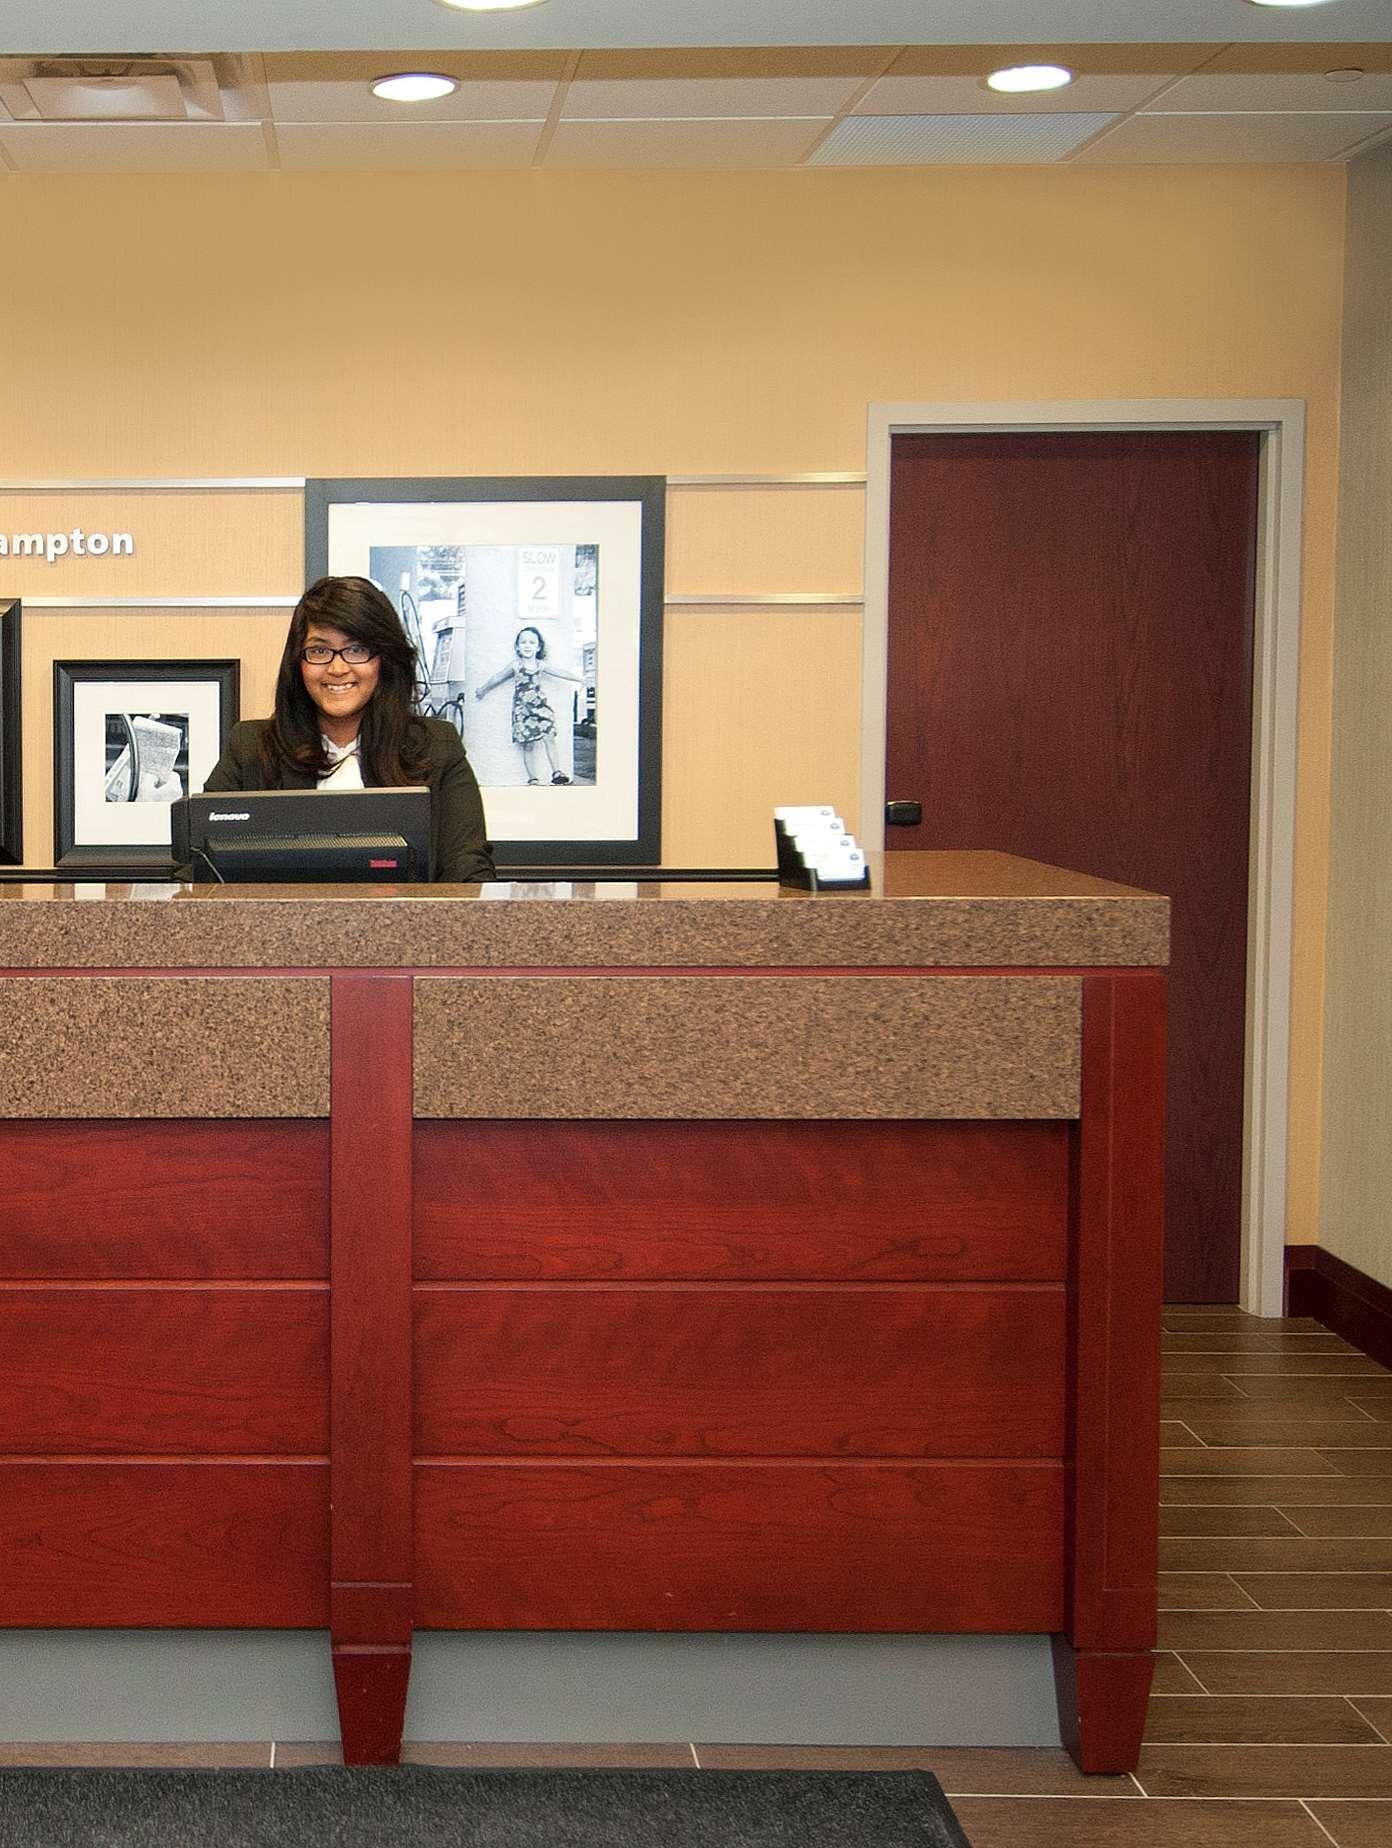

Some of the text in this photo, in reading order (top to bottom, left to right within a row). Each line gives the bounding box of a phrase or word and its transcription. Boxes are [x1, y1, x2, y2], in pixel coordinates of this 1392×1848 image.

[522, 551, 557, 565] SLOW
[532, 575, 547, 600] 2
[208, 811, 250, 822] lenovo
